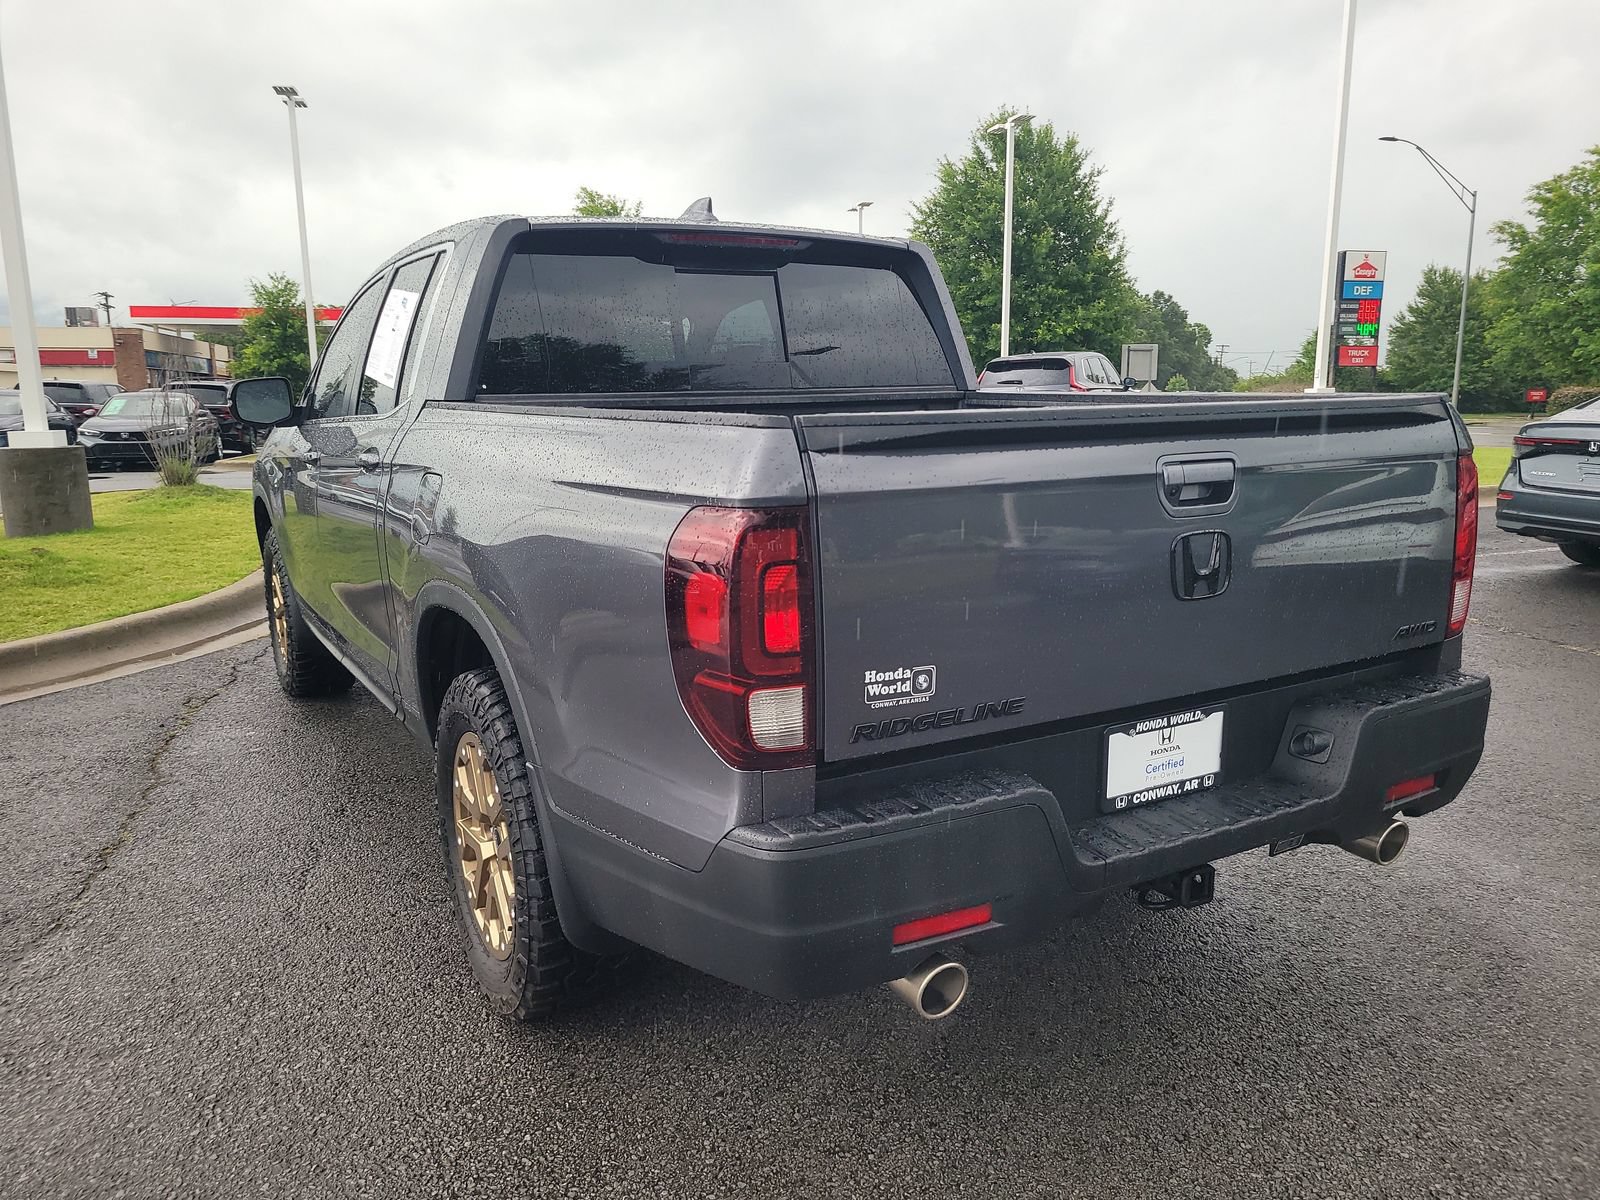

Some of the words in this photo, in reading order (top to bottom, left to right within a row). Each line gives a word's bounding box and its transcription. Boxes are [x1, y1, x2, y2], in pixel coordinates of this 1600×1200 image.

[1353, 285, 1374, 296] DEF
[1347, 349, 1370, 357] TRUCK
[864, 667, 912, 683] Honda
[867, 681, 911, 697] World
[871, 700, 898, 709] CONWAY,
[899, 696, 930, 706] ARKANSAS
[849, 696, 1026, 744] RIDGELINE
[1135, 717, 1168, 733] HONDA
[1170, 710, 1201, 725] WORLD
[1150, 744, 1181, 757] HONDA
[1145, 756, 1185, 774] Certified
[1145, 769, 1184, 782] Pre-Owned
[1132, 785, 1182, 804] CONWAY,
[1183, 779, 1199, 791] AR
